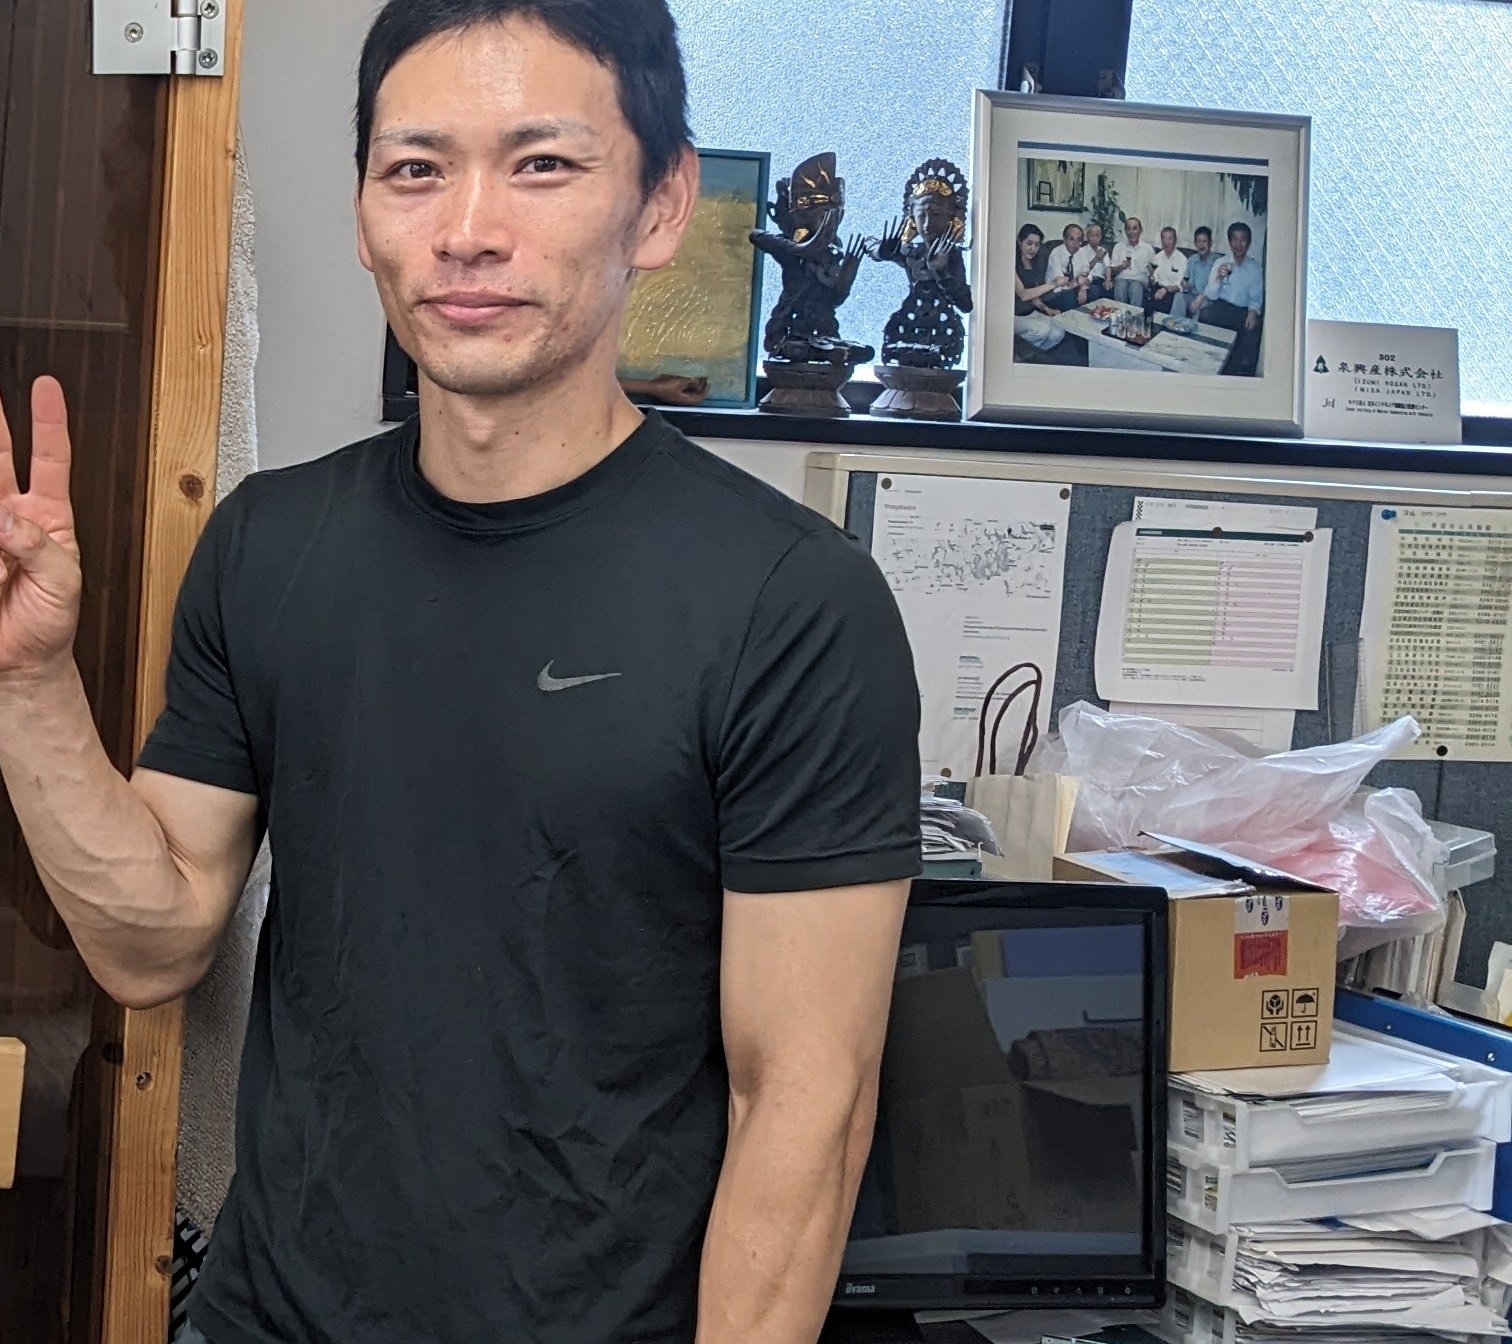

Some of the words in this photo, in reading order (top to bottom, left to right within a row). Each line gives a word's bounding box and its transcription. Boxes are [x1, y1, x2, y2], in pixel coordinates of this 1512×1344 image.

[1378, 353, 1396, 362] 302
[1338, 361, 1445, 380] 泉興産株式会社
[1386, 388, 1411, 397] JAPAN
